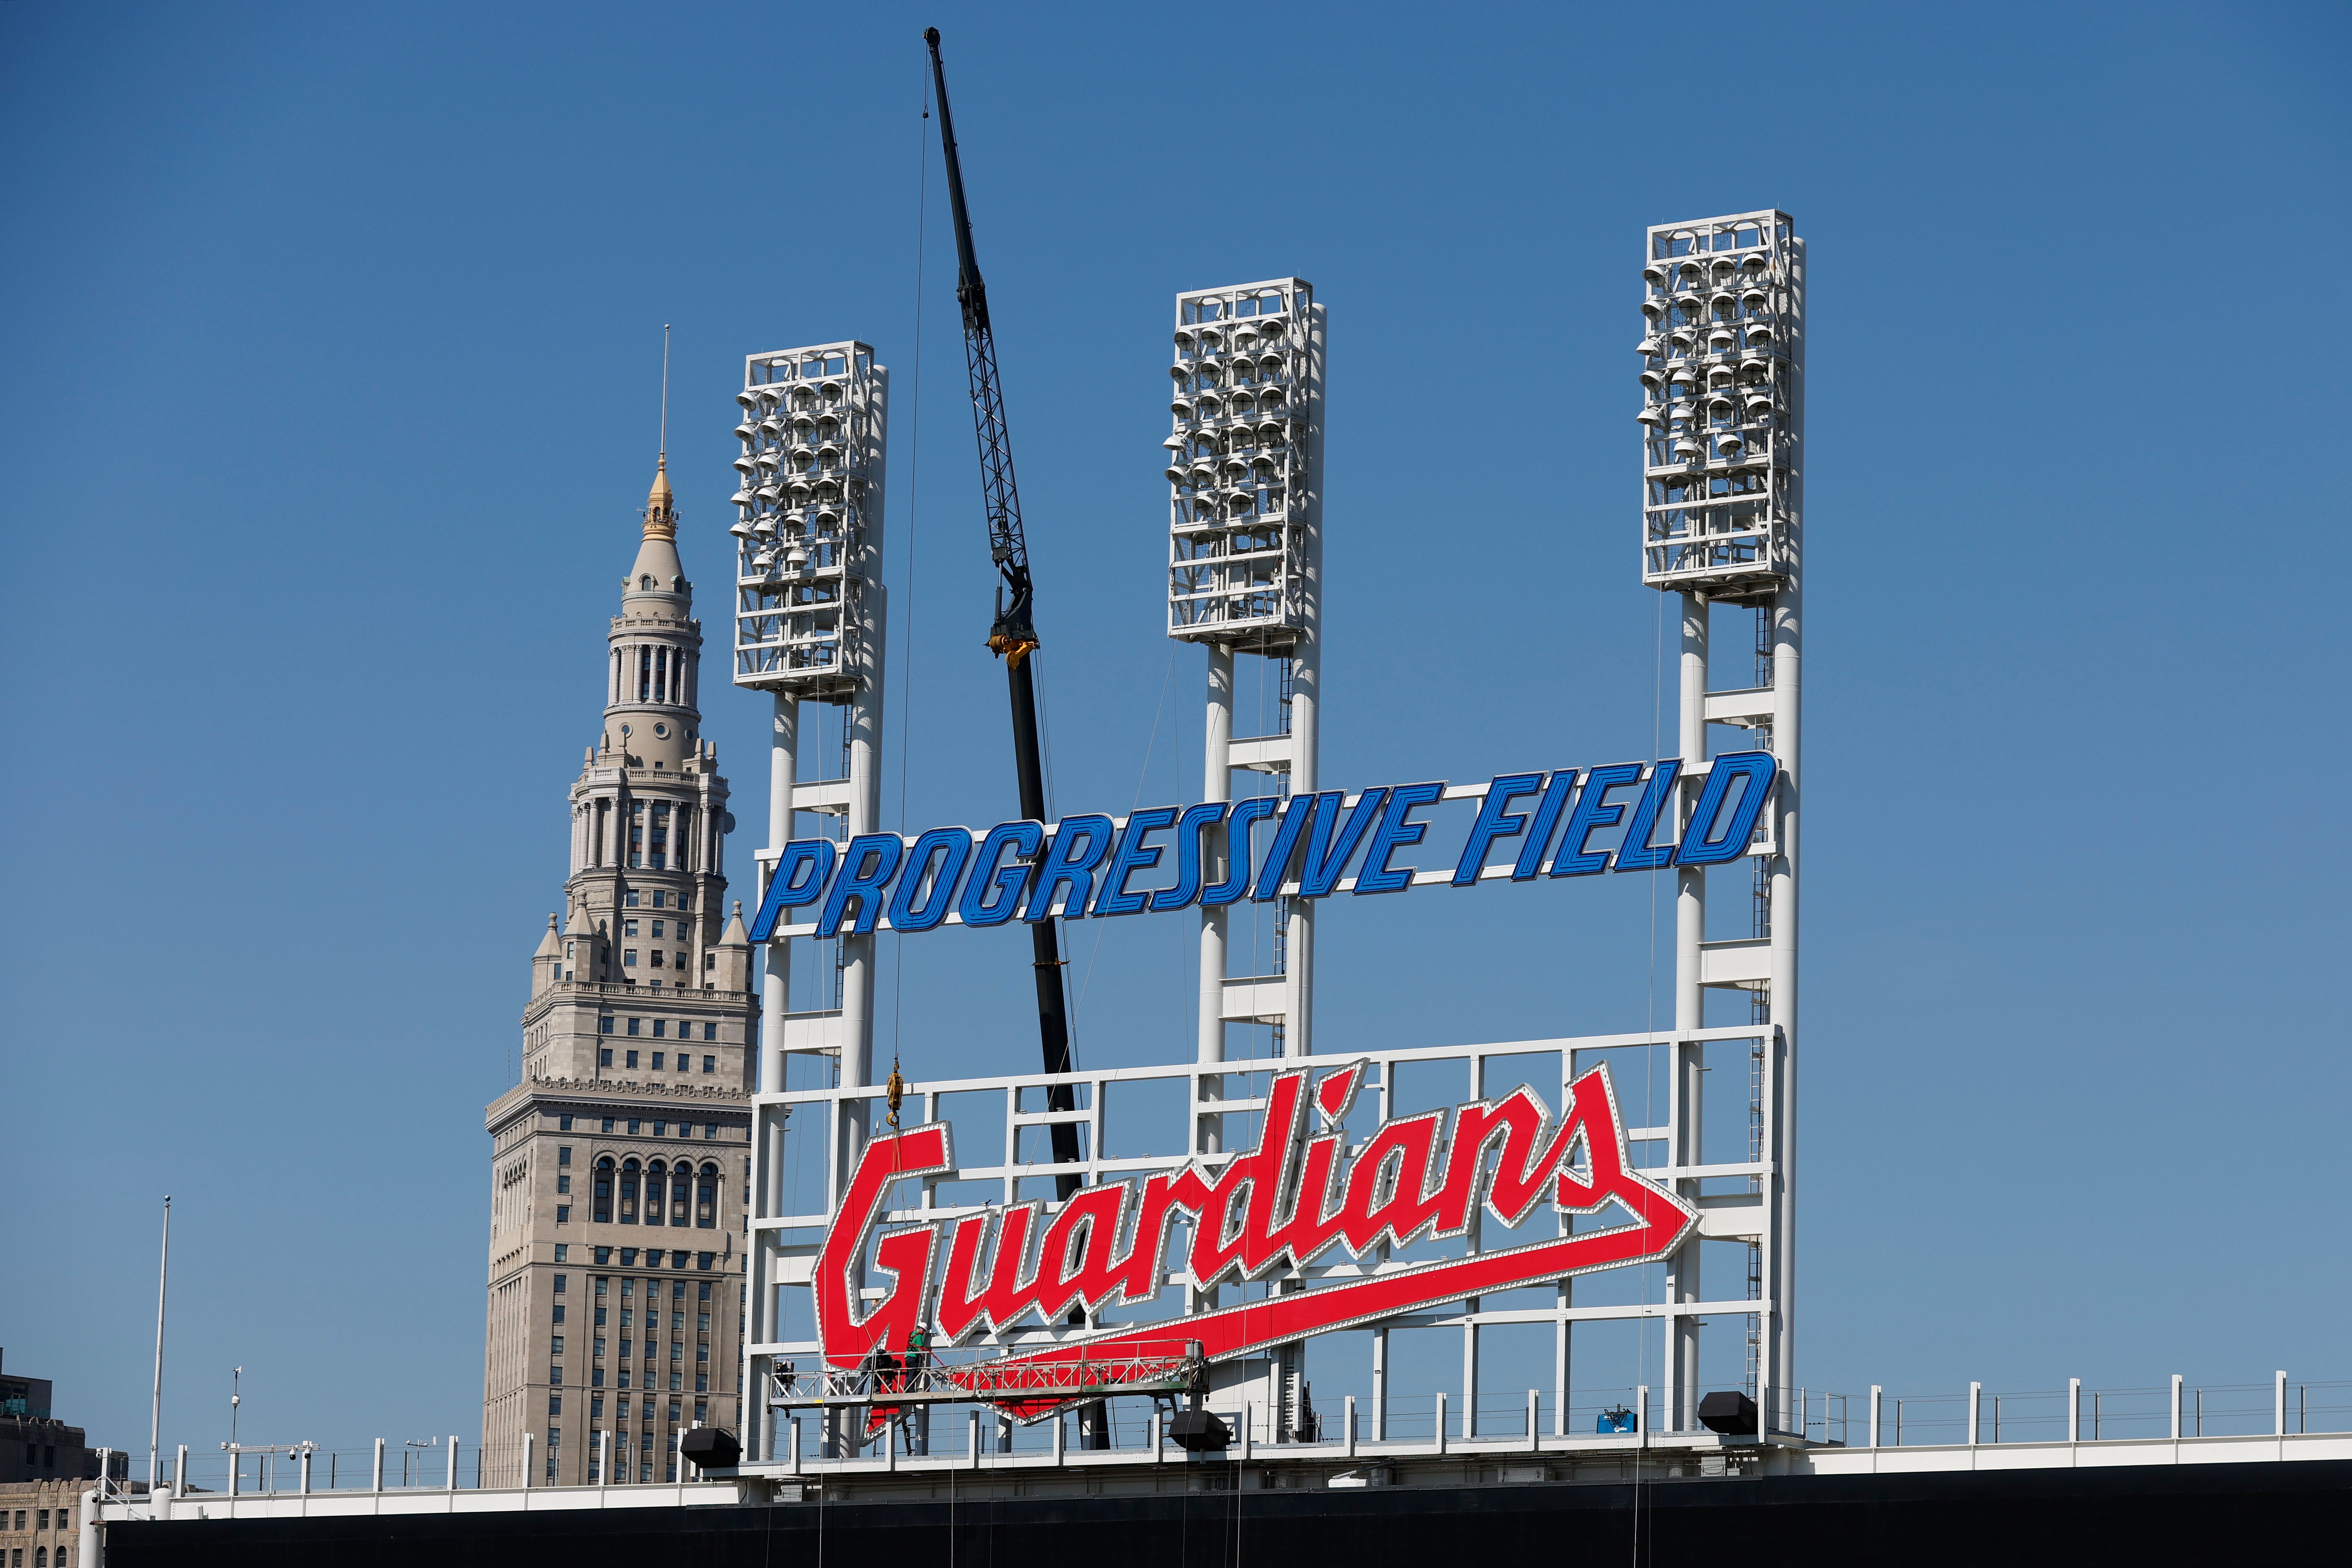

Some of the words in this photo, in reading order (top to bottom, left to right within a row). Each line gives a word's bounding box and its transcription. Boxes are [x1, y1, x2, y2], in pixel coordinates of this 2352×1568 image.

[747, 780, 1449, 944] PROGRESSIVE
[1450, 750, 1779, 888] FIELD
[811, 1057, 1700, 1441] Guardians
